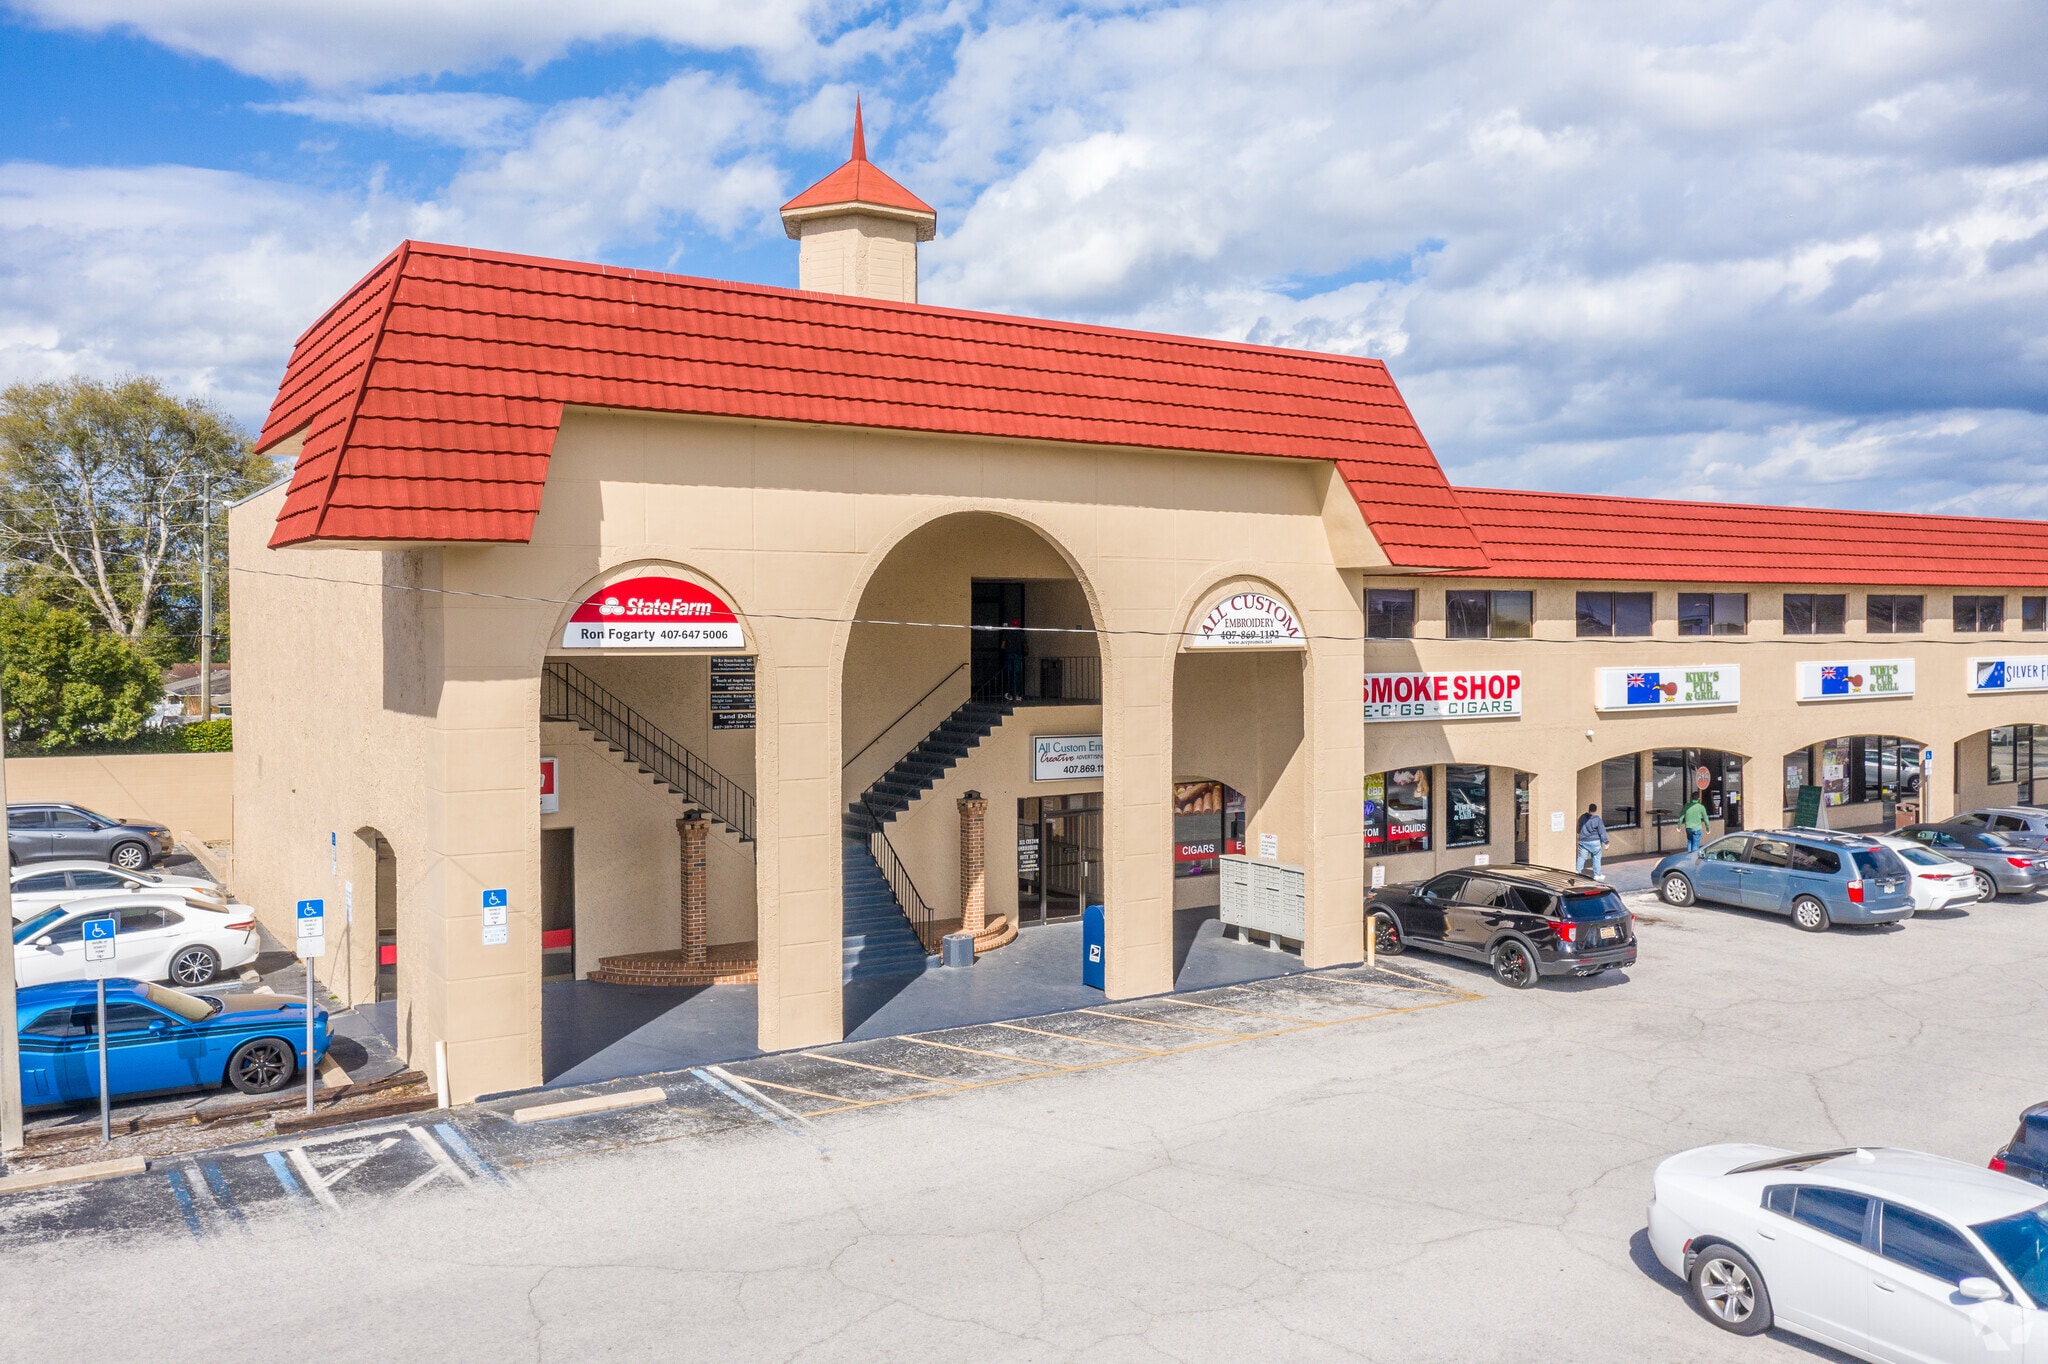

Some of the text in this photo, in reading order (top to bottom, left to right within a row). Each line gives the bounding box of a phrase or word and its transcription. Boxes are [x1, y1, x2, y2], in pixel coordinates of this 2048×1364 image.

[1202, 594, 1299, 640] ALL CUSTOM
[1224, 618, 1274, 628] EMBROIDERY
[581, 628, 604, 640] Ron
[608, 628, 655, 642] Fogarty
[1220, 630, 1280, 640] 407-869-1192
[1869, 665, 1899, 675] KIWI'S
[2006, 665, 2039, 683] SILVER
[1685, 671, 1720, 683] KIWI'S
[1875, 674, 1893, 684] PUB
[1453, 674, 1521, 701] SHOP
[1692, 682, 1713, 693] PUB
[1869, 683, 1899, 692] & GRILL
[1685, 690, 1720, 701] & GRILL
[1448, 700, 1513, 715] CIGARS
[1038, 742, 1051, 753] All
[1053, 742, 1087, 753] Custom
[1040, 751, 1075, 763] Creative
[1391, 823, 1426, 835] E-LIQUIDS
[1182, 843, 1215, 856] CIGARS
